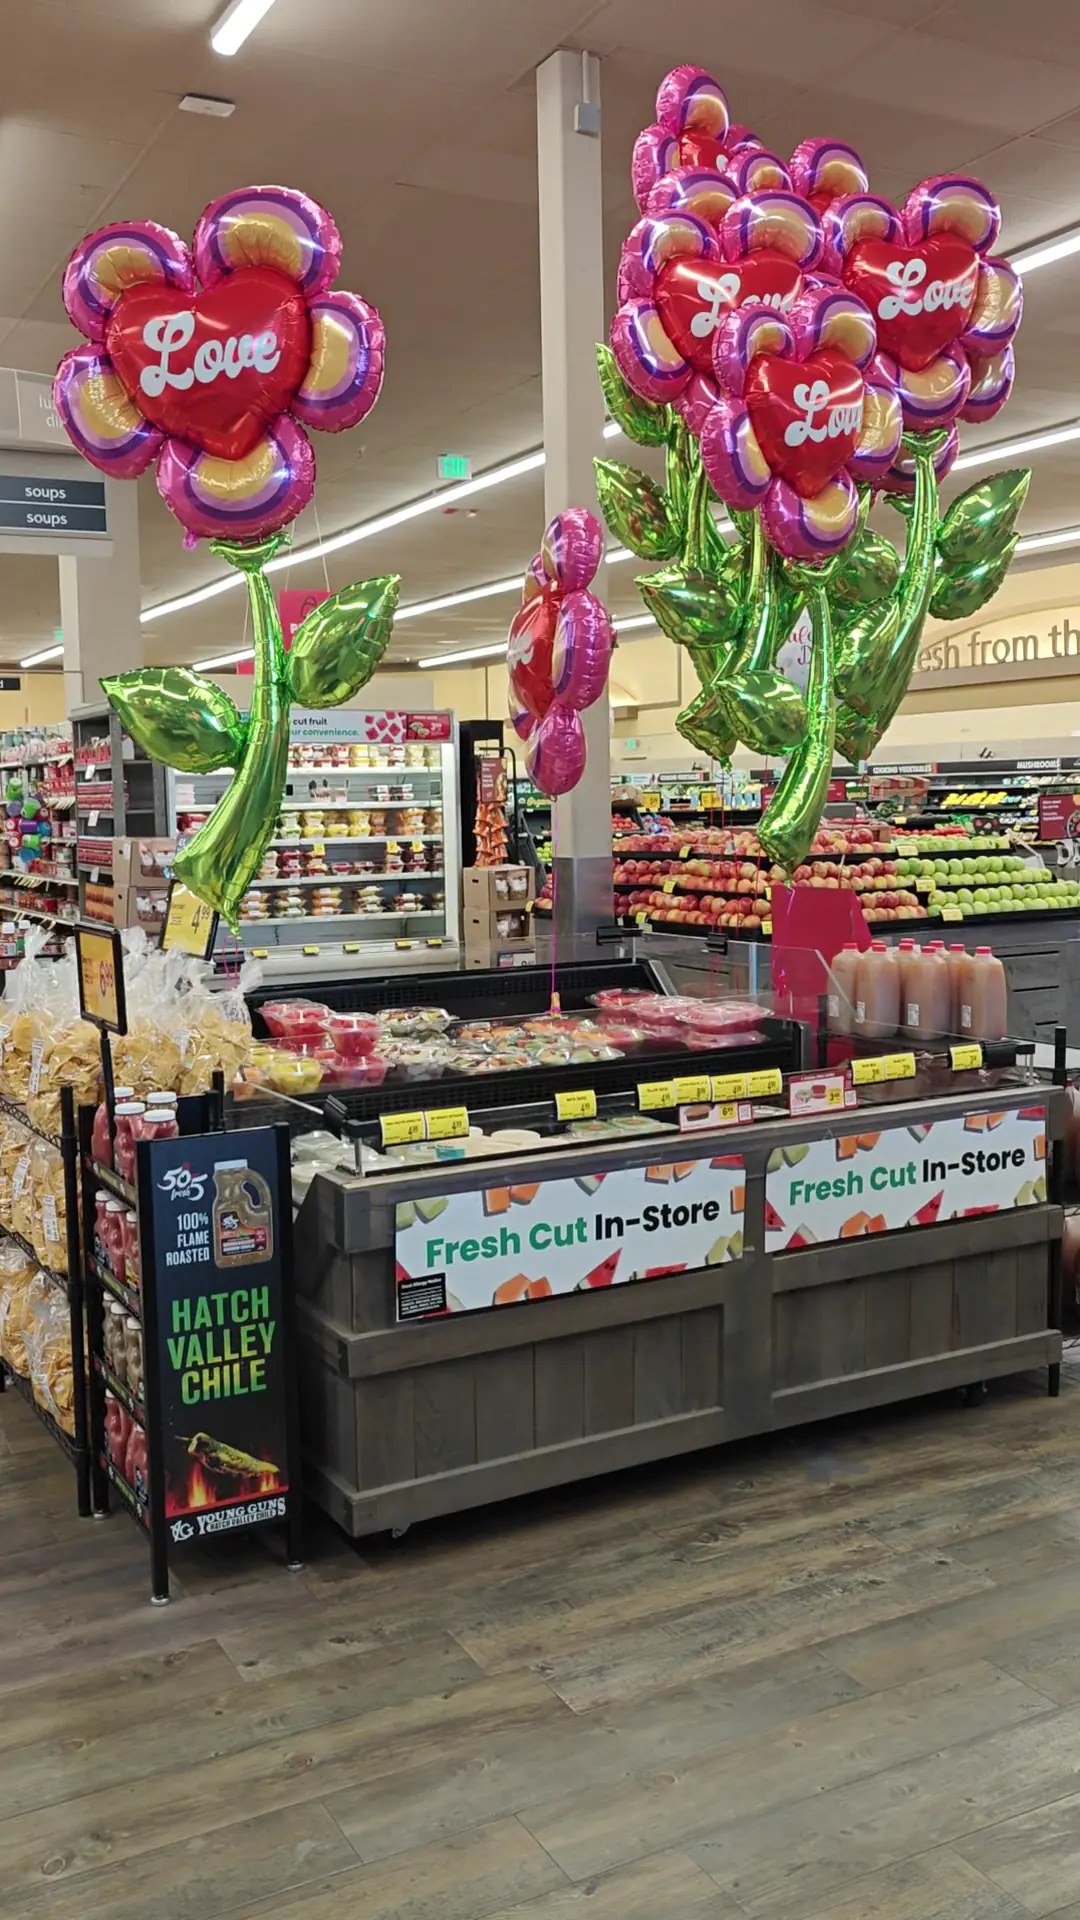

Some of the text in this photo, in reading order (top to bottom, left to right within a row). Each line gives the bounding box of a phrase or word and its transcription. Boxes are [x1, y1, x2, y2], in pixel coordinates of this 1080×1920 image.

[878, 258, 974, 320] Love
[140, 311, 281, 397] Love
[784, 380, 864, 448] Lov
[25, 487, 67, 501] soups
[26, 513, 68, 527] soups
[915, 636, 960, 673] esh
[967, 630, 1040, 668] from
[292, 716, 328, 726] cut fruit
[156, 1165, 209, 1202] 505
[789, 1148, 1026, 1206] Fresh Cut In-Store
[176, 1212, 209, 1232] 100%
[177, 1230, 209, 1249] FLAME
[425, 1200, 720, 1269] Fresh Cut In-Store
[166, 1246, 210, 1267] ROASTED
[172, 1286, 269, 1333] HATCH
[166, 1320, 276, 1371] VALLEY
[181, 1358, 268, 1406] CHILE
[196, 1497, 287, 1536] YOUNG GUNS
